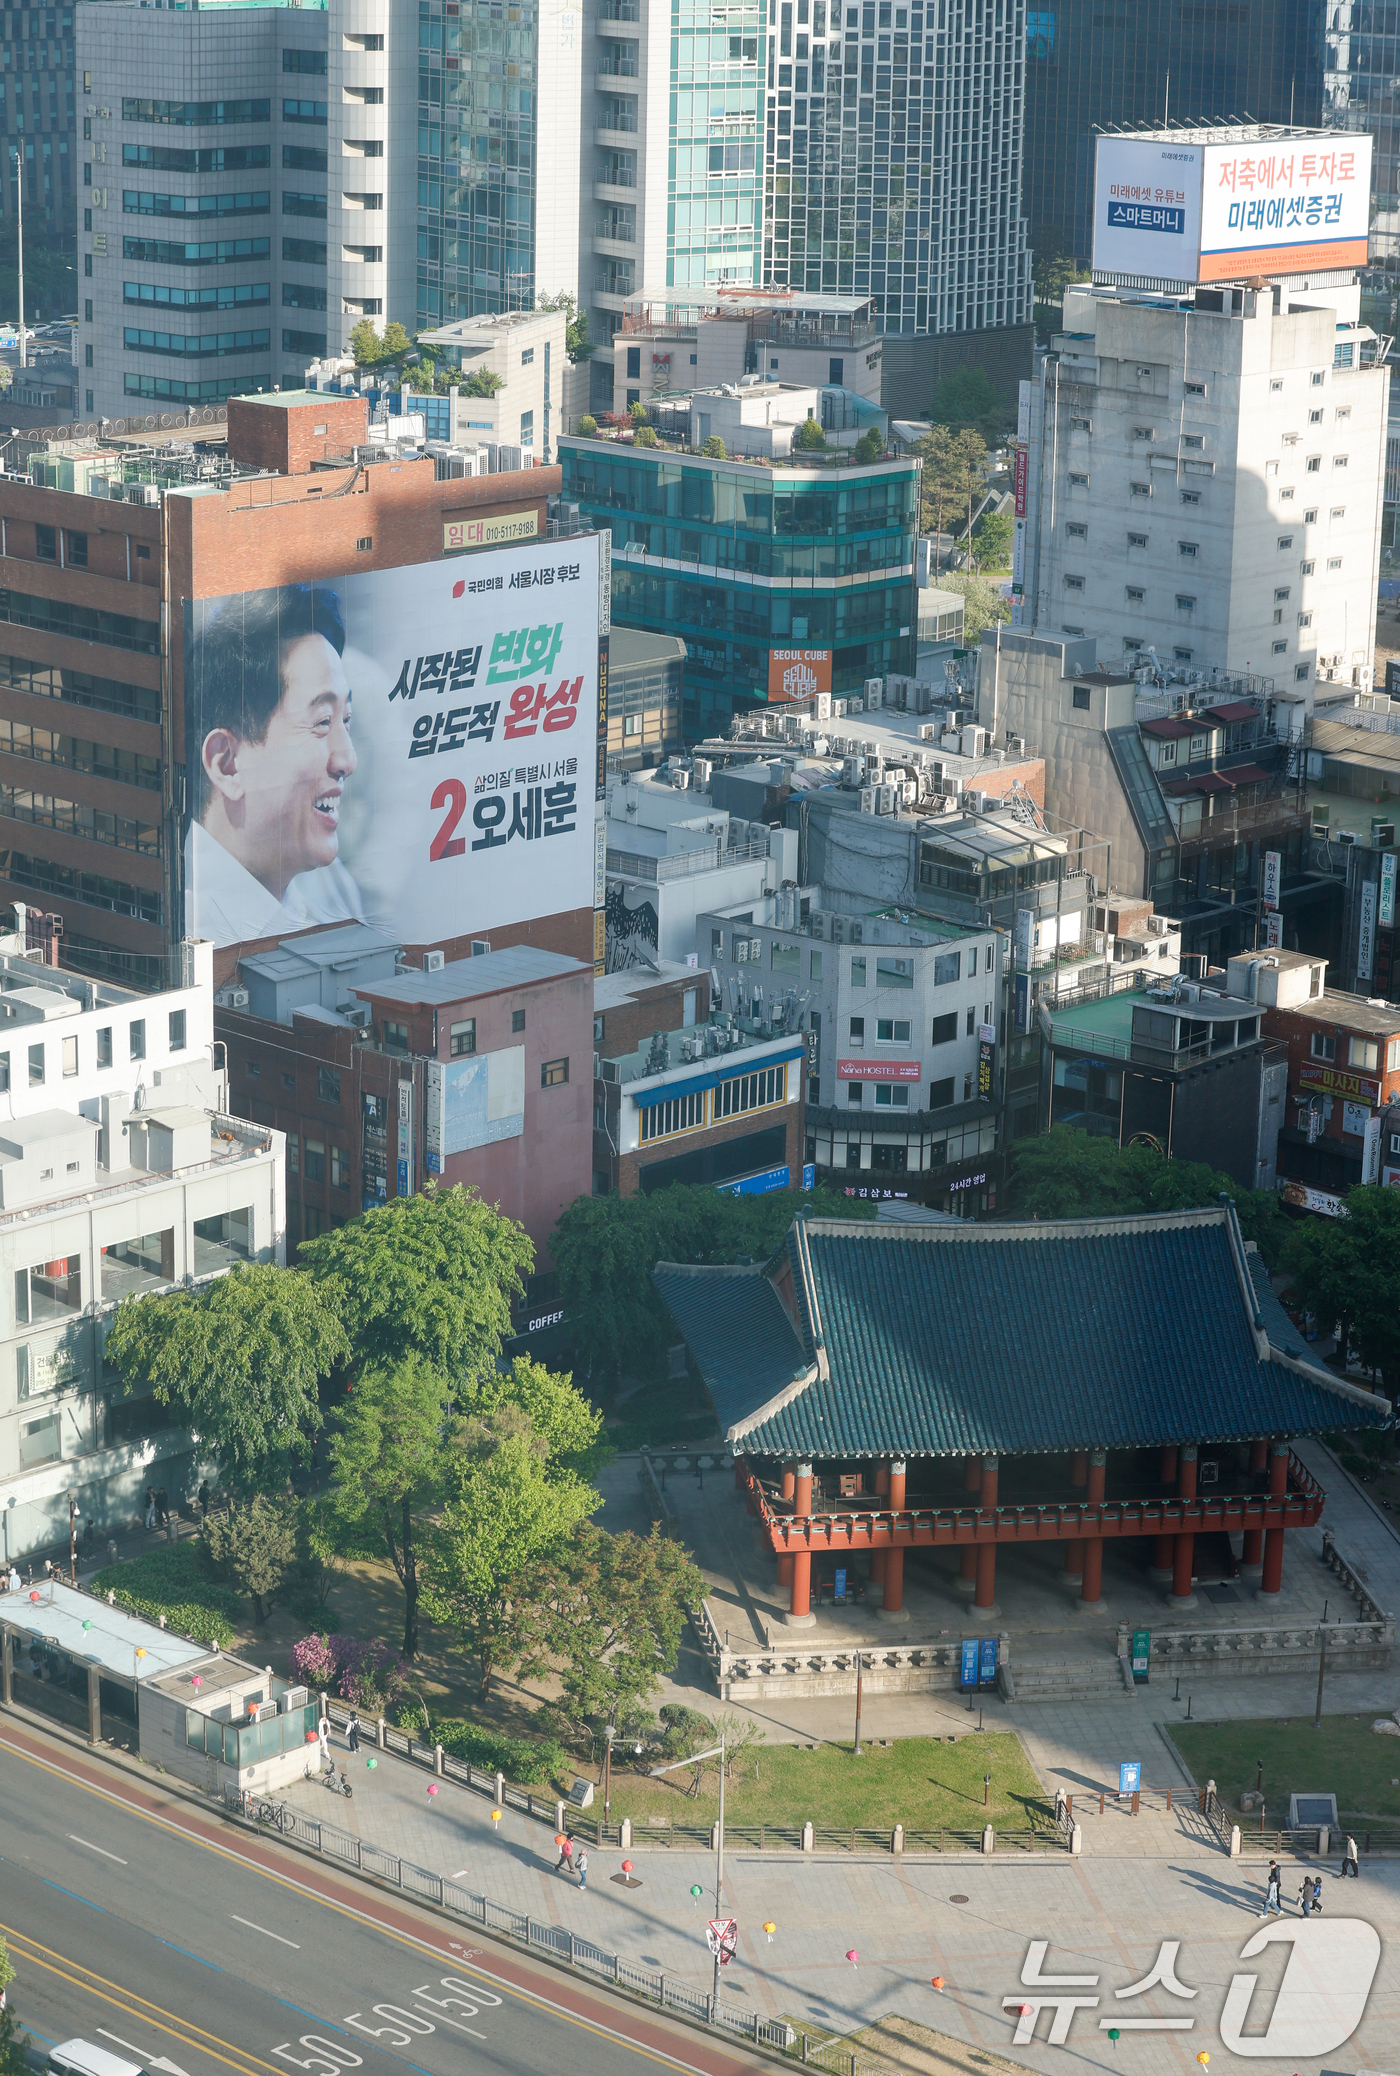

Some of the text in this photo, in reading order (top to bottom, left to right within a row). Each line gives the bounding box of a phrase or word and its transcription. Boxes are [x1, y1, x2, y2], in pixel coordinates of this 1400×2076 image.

[1161, 151, 1194, 163] 미래에셋증권
[1218, 151, 1356, 193] 저축에서 투자로
[91, 141, 108, 258] 나이트
[1110, 183, 1185, 204] 미래에셋 유튜브
[1112, 206, 1179, 231] 스마트머니
[1227, 192, 1343, 232] 미래에셋증권
[448, 520, 535, 546] 임대 010-5117-9188
[468, 563, 580, 593] 국민의힘 서울시장 후보
[388, 622, 564, 702] 시작된 변화
[773, 650, 828, 661] SEOUL CUBE
[598, 652, 608, 723] NUGUNA
[408, 675, 585, 759] 압도적 완성
[474, 757, 578, 794] 삶의질 특별시 서울
[429, 778, 578, 862] 2 오세훈
[1266, 862, 1276, 893] 하우스
[1363, 898, 1371, 924] 부동산
[1381, 876, 1392, 921] 플로리스트
[1268, 921, 1278, 949] 노래
[1361, 926, 1370, 960] 중개법인
[808, 1033, 819, 1064] 타로
[863, 1066, 898, 1076] HOSTEL
[1301, 1069, 1323, 1079] HAPPY
[1323, 1069, 1360, 1094] 마사지
[859, 1187, 892, 1198] 김삼보
[950, 1173, 986, 1192] 24시간 영업
[528, 1310, 564, 1331] COFFEE
[411, 1977, 503, 2017] 50
[343, 2003, 436, 2046] 50
[270, 2034, 364, 2076] 50
